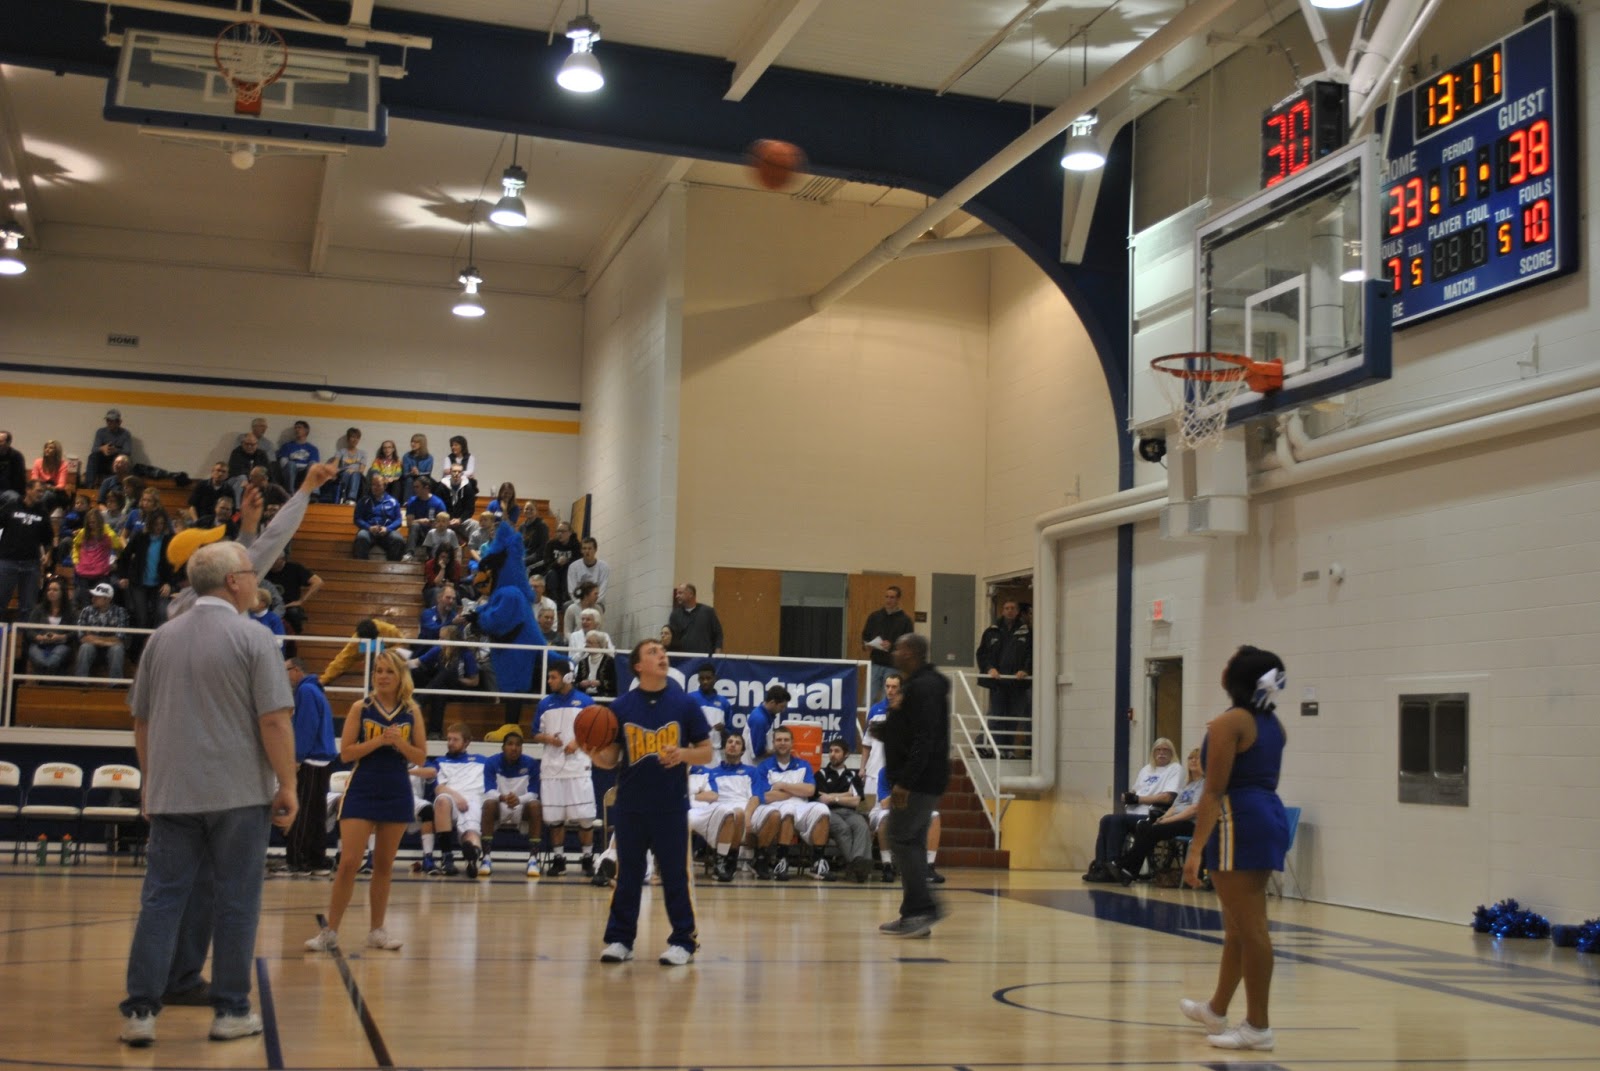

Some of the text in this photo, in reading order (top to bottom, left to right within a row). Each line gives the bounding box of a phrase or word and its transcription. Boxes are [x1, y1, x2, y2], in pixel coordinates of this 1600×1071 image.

[1428, 51, 1502, 127] 13:11
[1498, 88, 1545, 131] GUEST
[1267, 100, 1310, 187] 30
[1442, 136, 1474, 163] PERIOD
[1508, 120, 1549, 185] 38
[1459, 166, 1468, 197] 1
[1519, 178, 1552, 205] FOULS
[1389, 177, 1423, 235] 33
[1428, 204, 1490, 241] PLAYER FOUL
[1524, 199, 1549, 243] 10
[1381, 239, 1404, 260] OULS
[1498, 222, 1512, 253] 5
[1387, 256, 1402, 292] 7
[1410, 258, 1423, 286] 5
[1520, 248, 1553, 275] SCORE
[1443, 276, 1475, 301] MATCH
[109, 336, 137, 345] HOME
[688, 674, 843, 711] enral
[363, 719, 411, 743] TAR
[624, 721, 680, 766] TABOR
